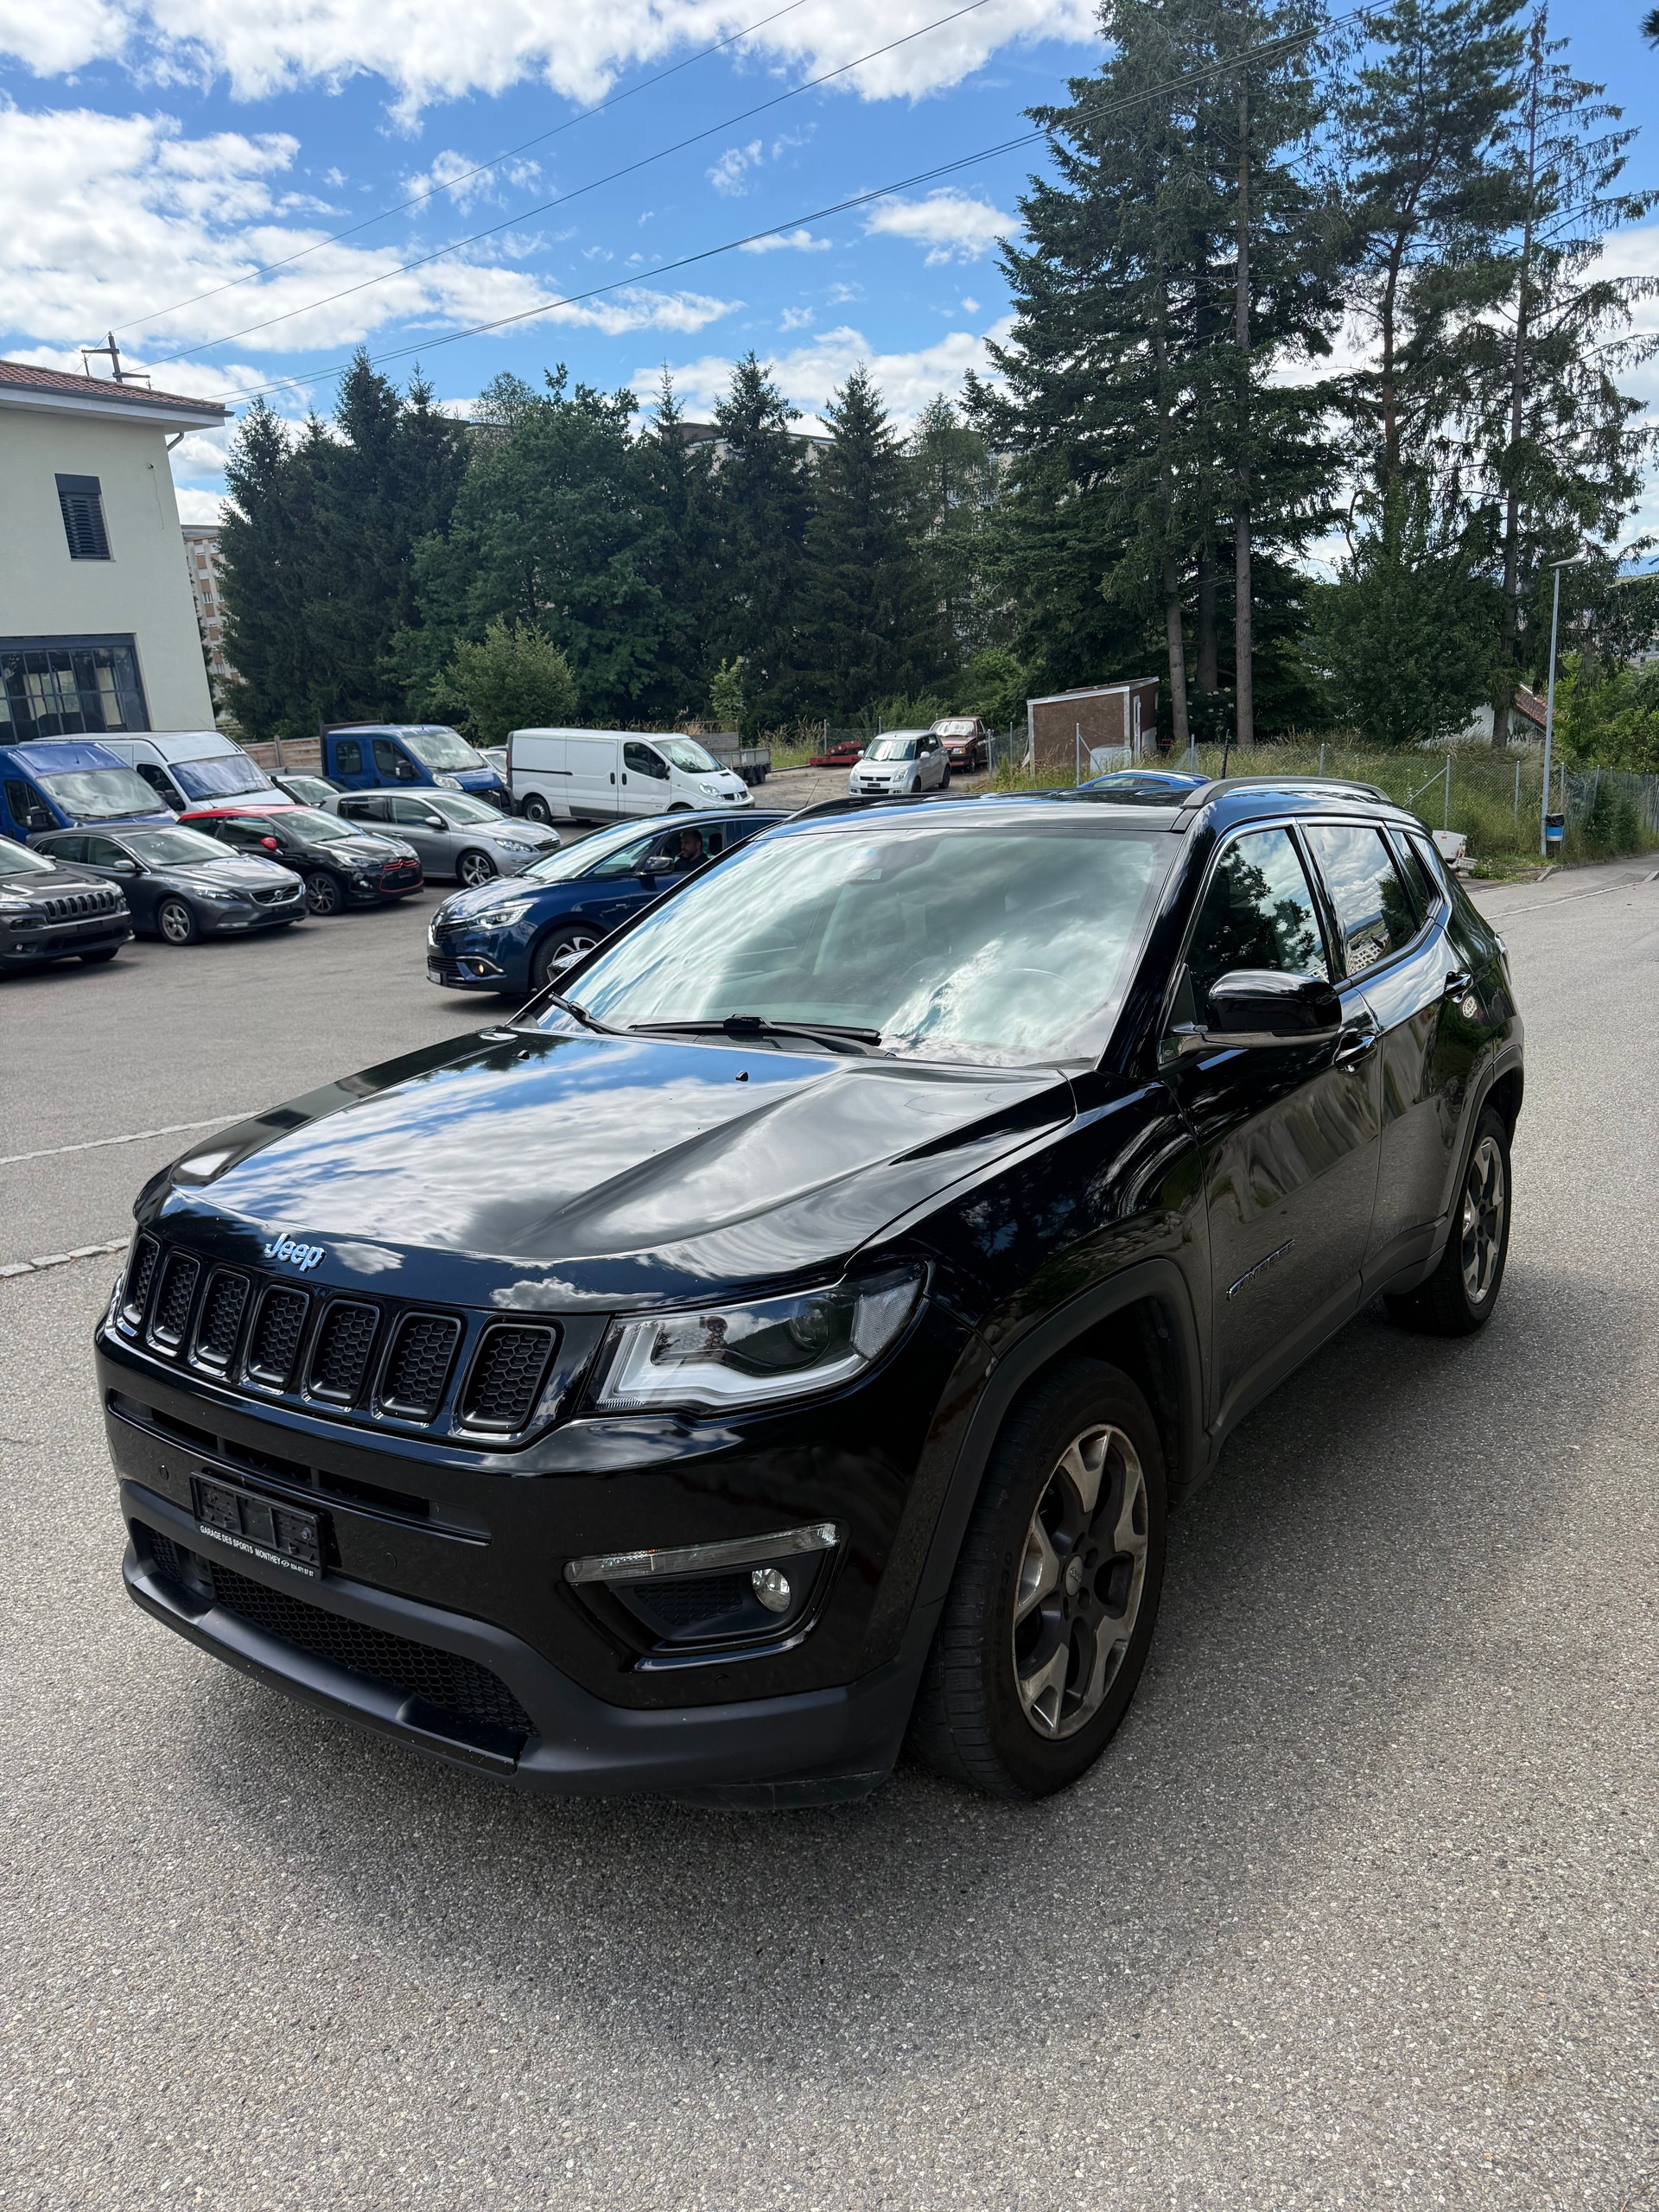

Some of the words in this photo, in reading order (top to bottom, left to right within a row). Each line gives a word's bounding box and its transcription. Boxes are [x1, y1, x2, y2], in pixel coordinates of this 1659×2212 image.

[264, 1233, 327, 1273] Jeep
[200, 1525, 222, 1541] GARAGE
[222, 1534, 232, 1545] DES
[232, 1539, 254, 1554] SPORTS
[255, 1548, 281, 1565] MONTHEY
